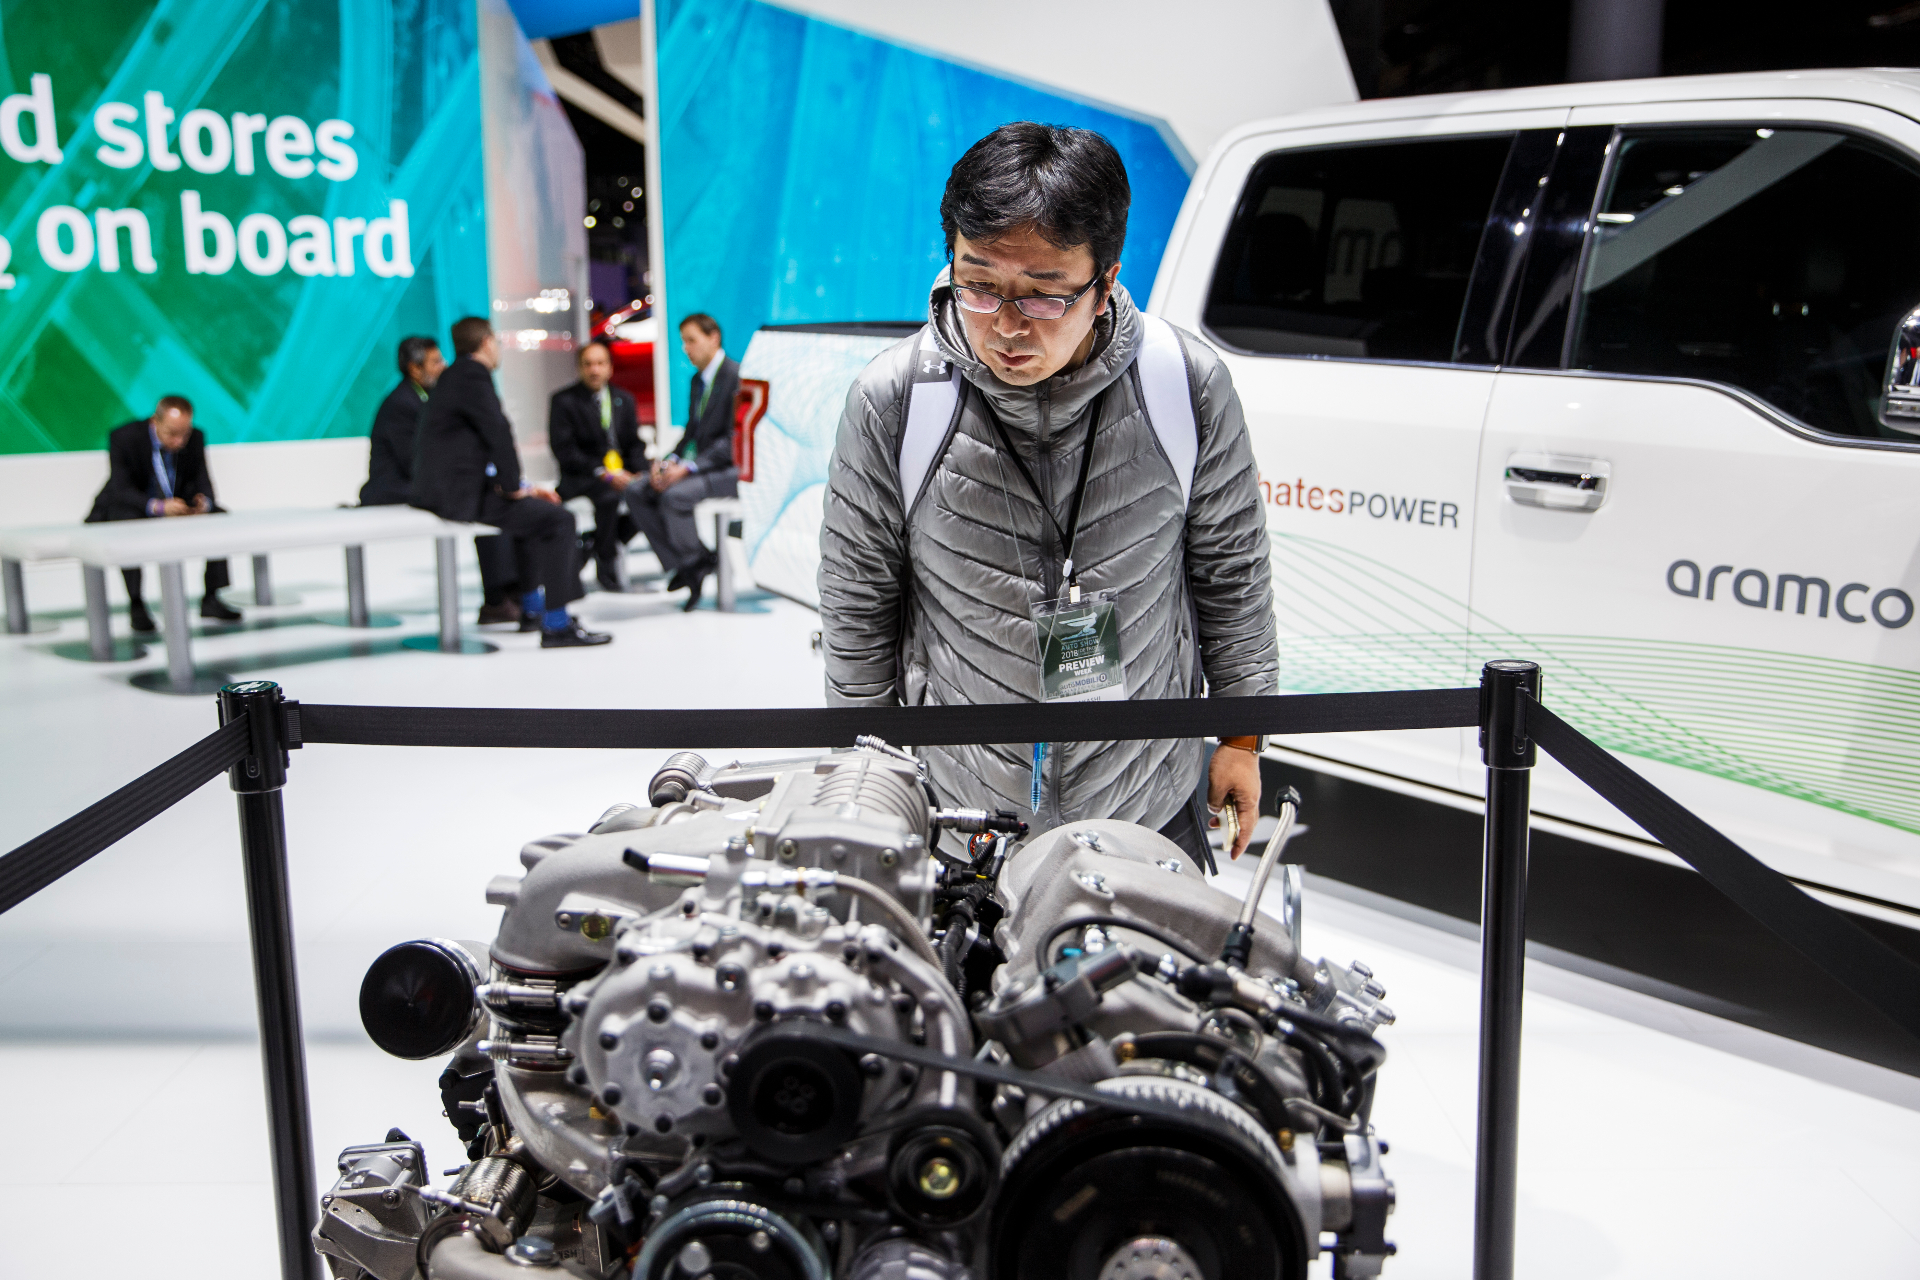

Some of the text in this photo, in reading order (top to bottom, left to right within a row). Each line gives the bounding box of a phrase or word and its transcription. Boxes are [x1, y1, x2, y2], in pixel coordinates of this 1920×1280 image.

[0, 72, 359, 182] d stores
[36, 204, 158, 274] on
[180, 189, 415, 278] board
[1666, 558, 1914, 630] aramco
[1061, 642, 1079, 651] AUTO
[1061, 650, 1079, 660] 2018
[1058, 655, 1105, 673] PREVIEW
[1074, 667, 1093, 677] WEEK
